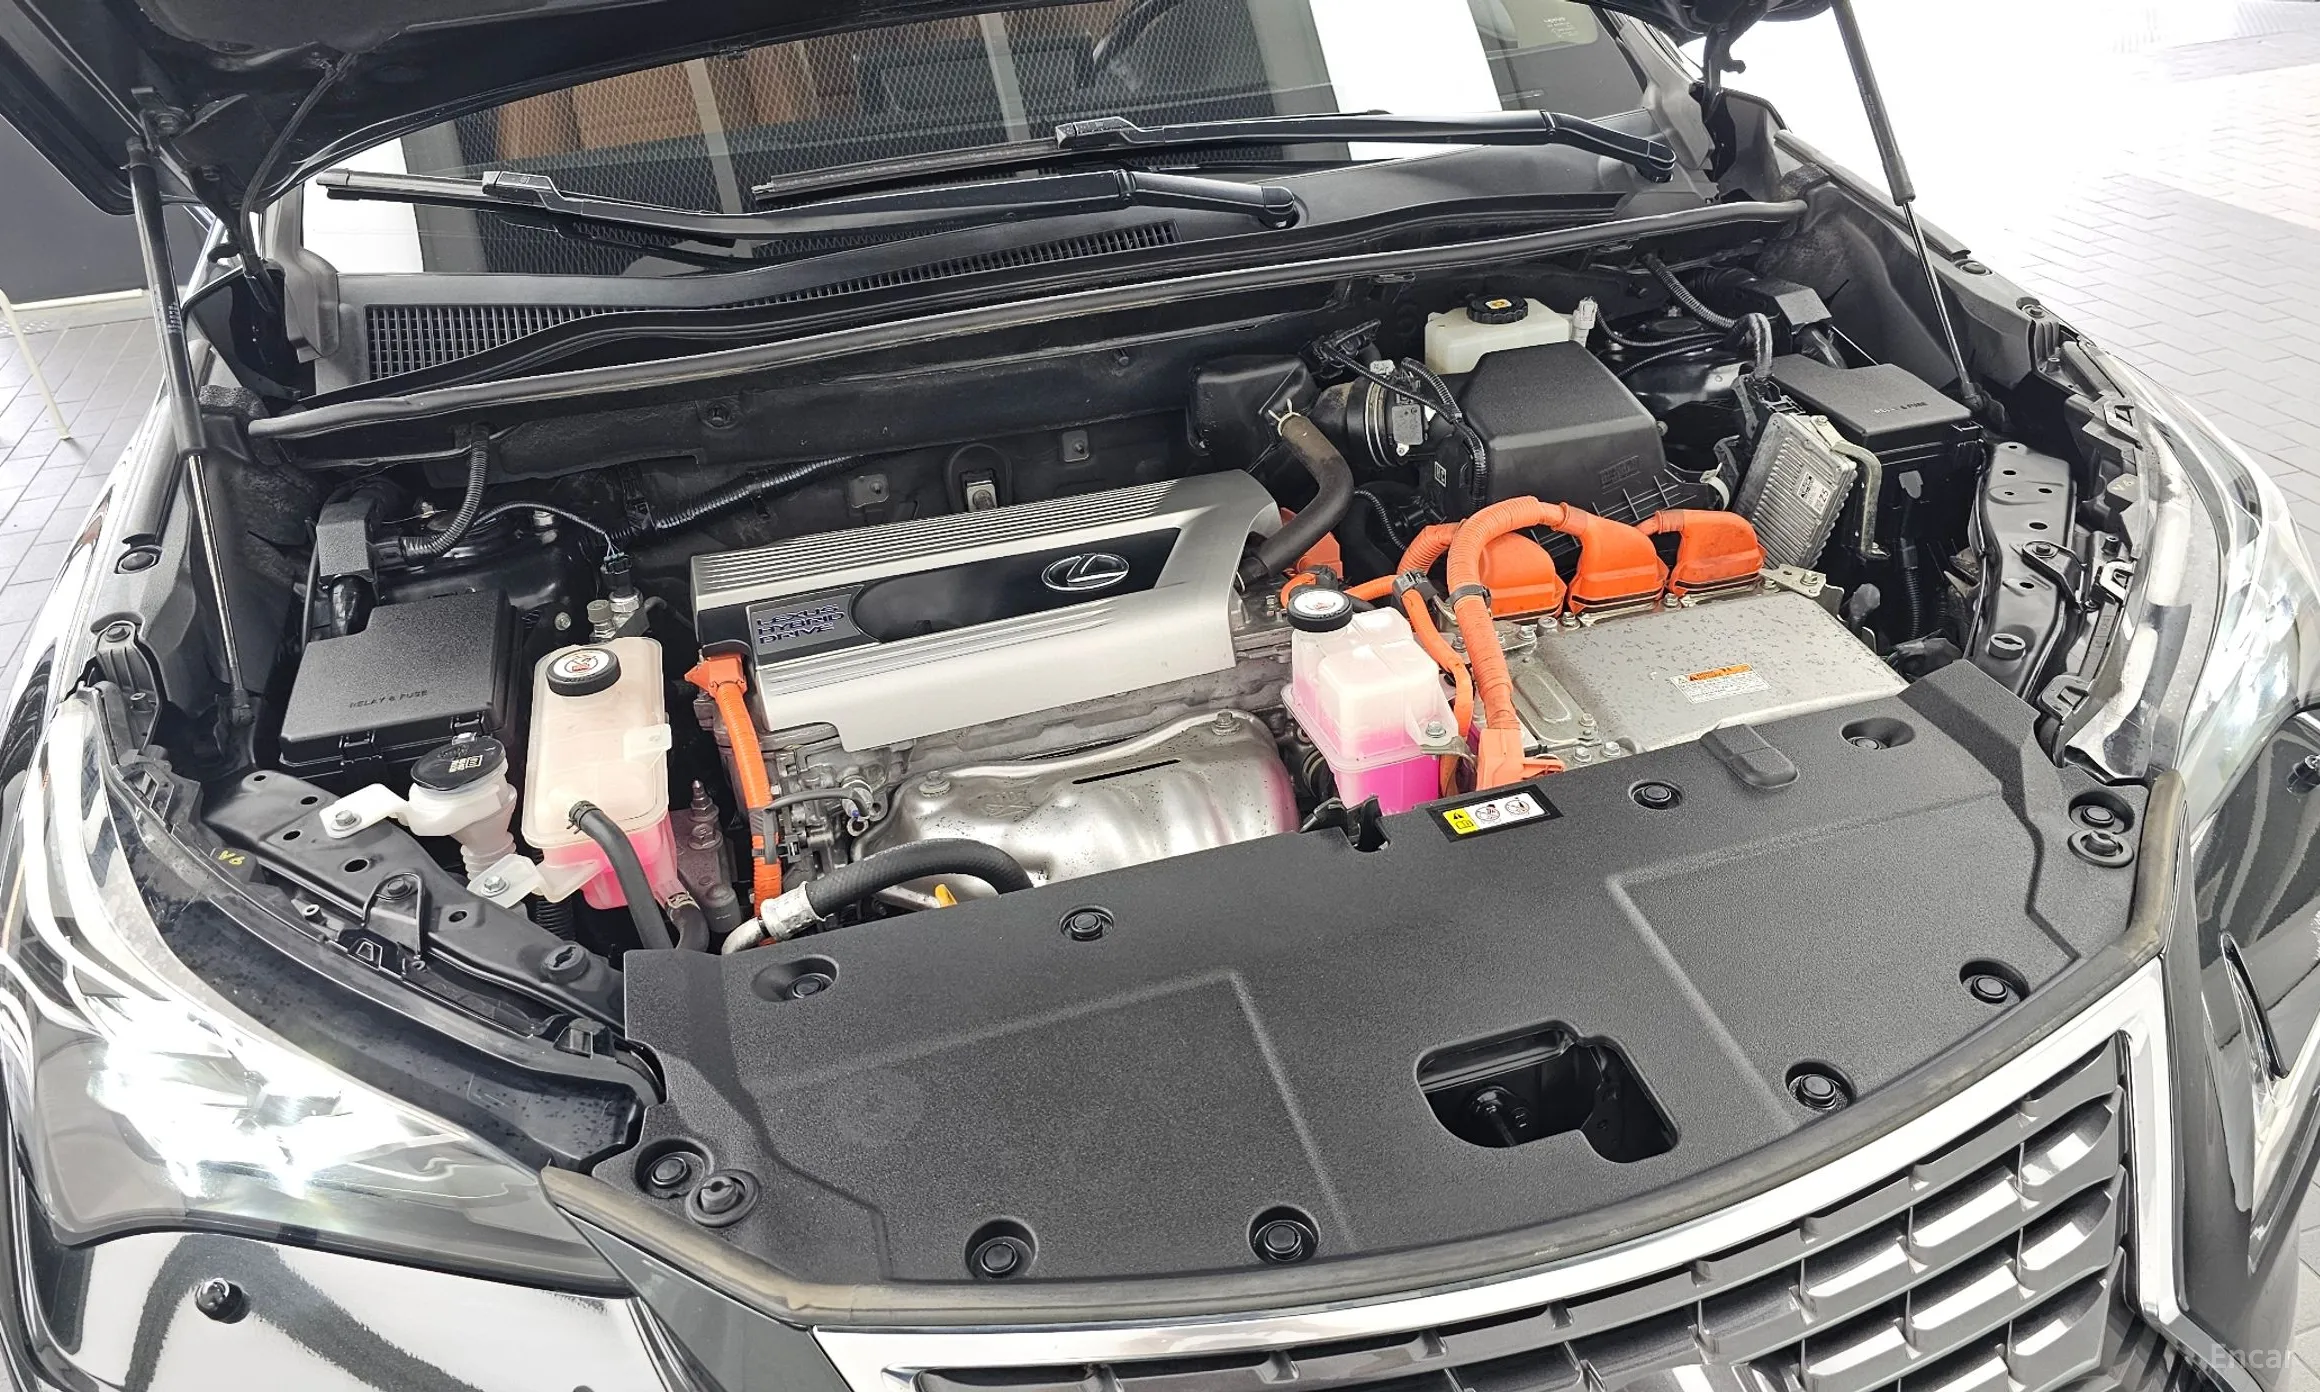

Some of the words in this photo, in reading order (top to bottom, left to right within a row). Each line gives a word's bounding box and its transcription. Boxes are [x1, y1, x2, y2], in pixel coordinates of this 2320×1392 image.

[757, 603, 840, 626] LEXUS
[757, 611, 845, 636] HYBRID
[759, 621, 835, 644] DRIVE
